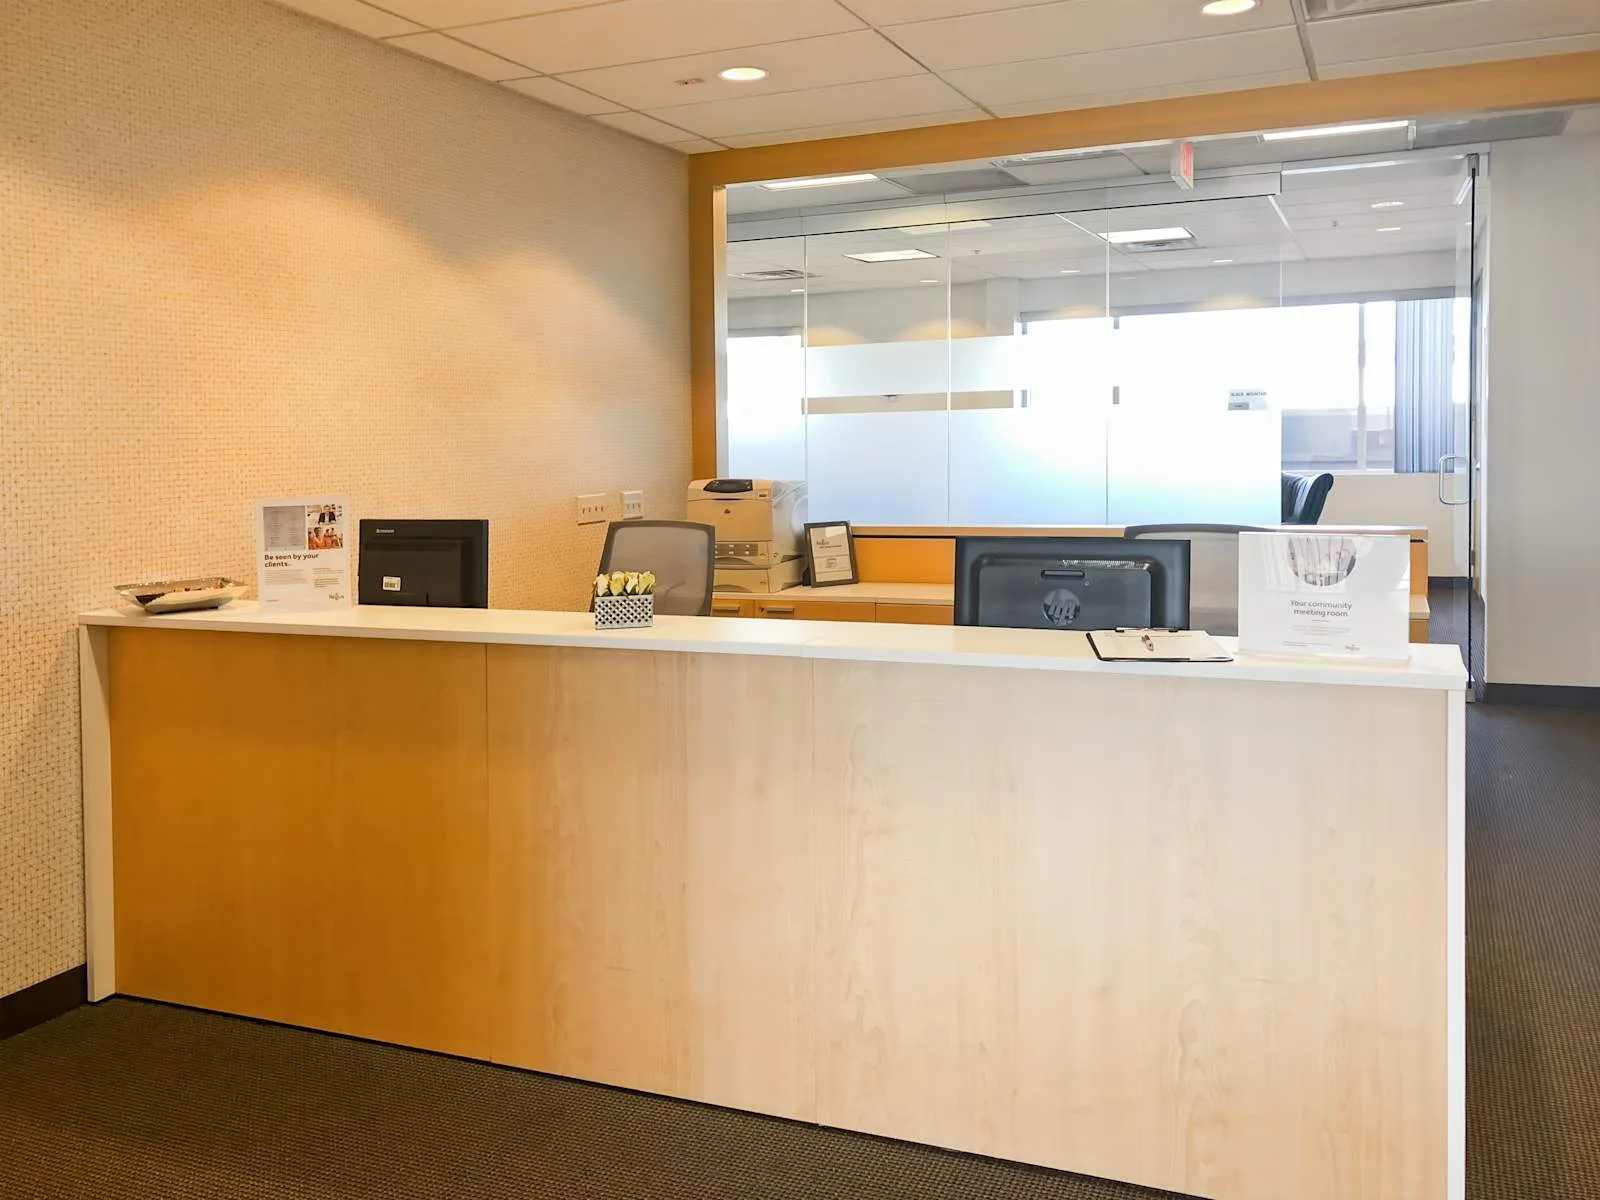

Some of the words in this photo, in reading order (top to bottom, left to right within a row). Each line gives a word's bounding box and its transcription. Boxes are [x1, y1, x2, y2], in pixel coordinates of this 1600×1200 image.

[1046, 590, 1079, 626] hp
[1308, 601, 1352, 610] community
[1294, 609, 1326, 617] meeting
